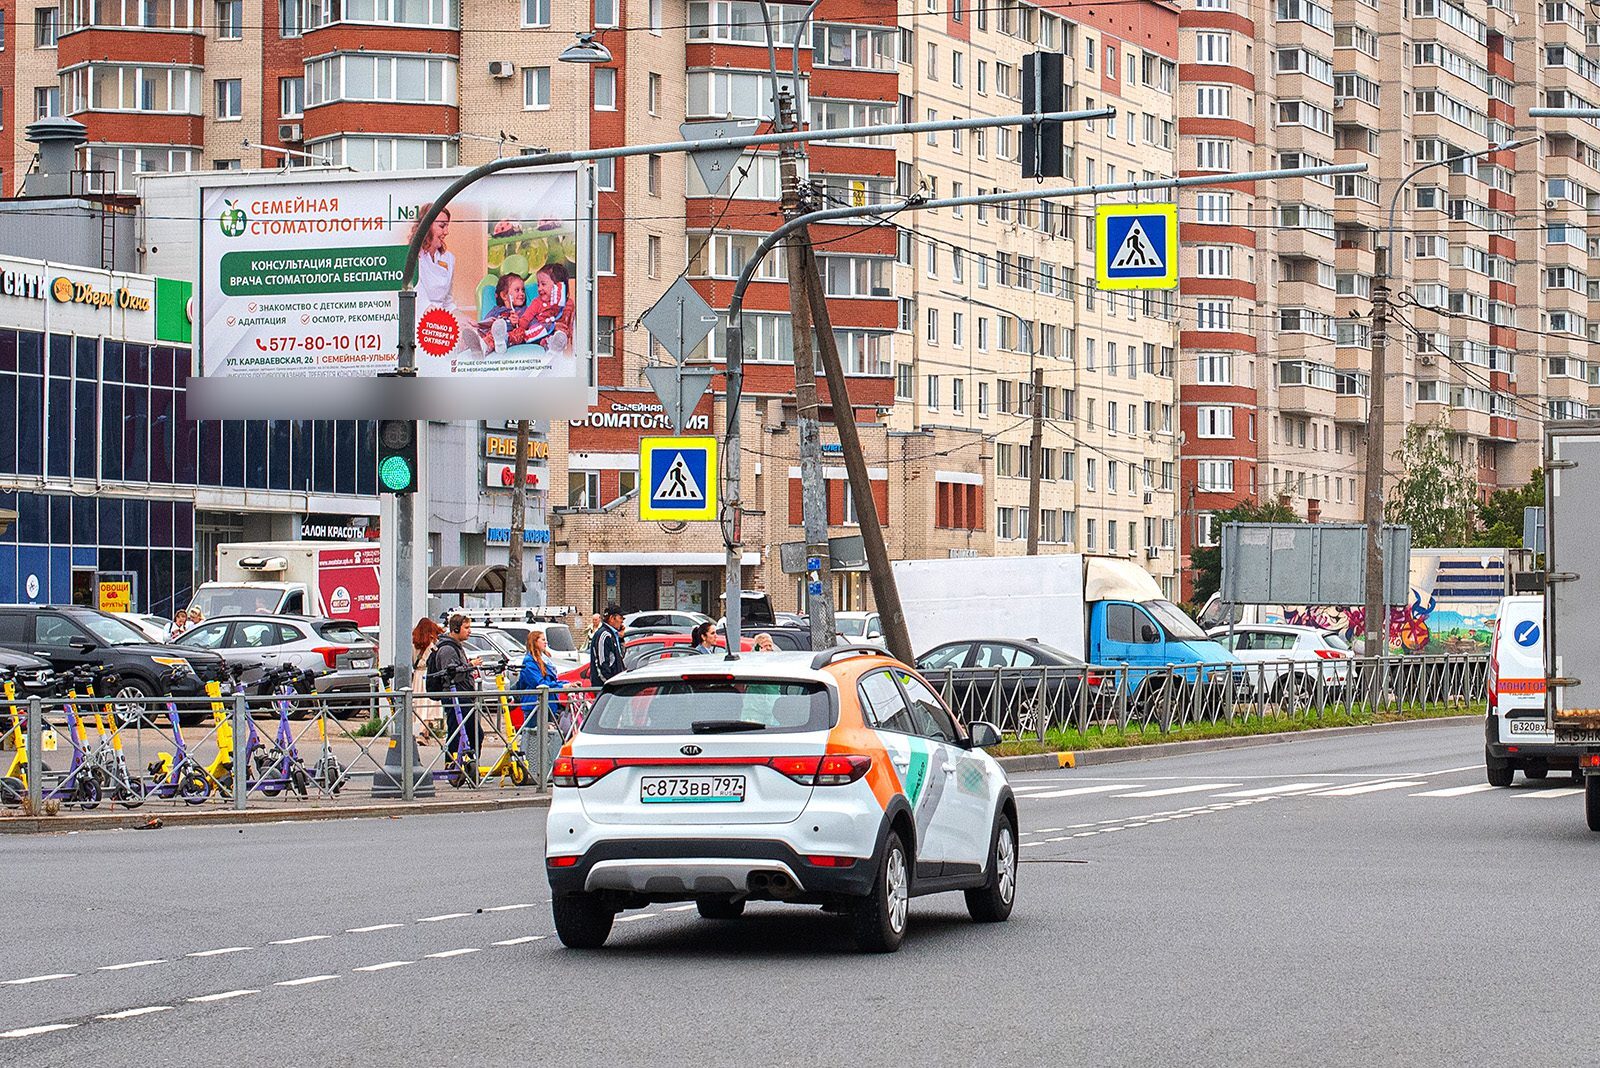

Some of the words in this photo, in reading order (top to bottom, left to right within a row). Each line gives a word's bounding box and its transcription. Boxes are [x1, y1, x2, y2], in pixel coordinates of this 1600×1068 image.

[251, 196, 338, 215] СЕМЕЙНАЯ
[398, 205, 419, 220] №1
[251, 216, 383, 235] СТОМАТОЛОГИЯ
[251, 258, 332, 271] КОНСУЛЬТАЦИЯ
[334, 256, 387, 269] ДЕТСКОГО
[3, 269, 47, 299] СИТИ
[230, 275, 263, 286] ВРАЧА
[265, 272, 341, 285] СТОМАТОЛОГА
[343, 270, 404, 283] БЕСПЛАТНО
[75, 282, 114, 309] Двери
[119, 287, 150, 312] Окна
[259, 303, 312, 312] ЗНАКОМСТВО
[313, 302, 319, 310] С
[320, 301, 357, 311] ДЕТСКИМ
[358, 300, 392, 309] ВРАЧОМ
[238, 317, 287, 326] АДАПТАЦИЯ
[312, 315, 347, 324] ОСМОТР,
[269, 335, 350, 351] 577-80-10
[354, 334, 381, 351] (12)
[226, 358, 239, 366] УЛ.
[240, 356, 303, 366] КАРАВАЕВСКАЯ,
[304, 356, 314, 364] 26
[611, 402, 663, 412] СЕМЕЙНАЯ
[570, 412, 709, 430] ТОМАТОЛОИЯ
[488, 436, 549, 459] РЫБЛКА
[301, 525, 327, 537] САЛОН
[327, 526, 365, 539] КРАСОТЫ
[100, 584, 129, 592] ОВОЩИ
[682, 746, 700, 754] KIA
[646, 780, 711, 796] С873ВВ
[714, 778, 740, 791] 797
